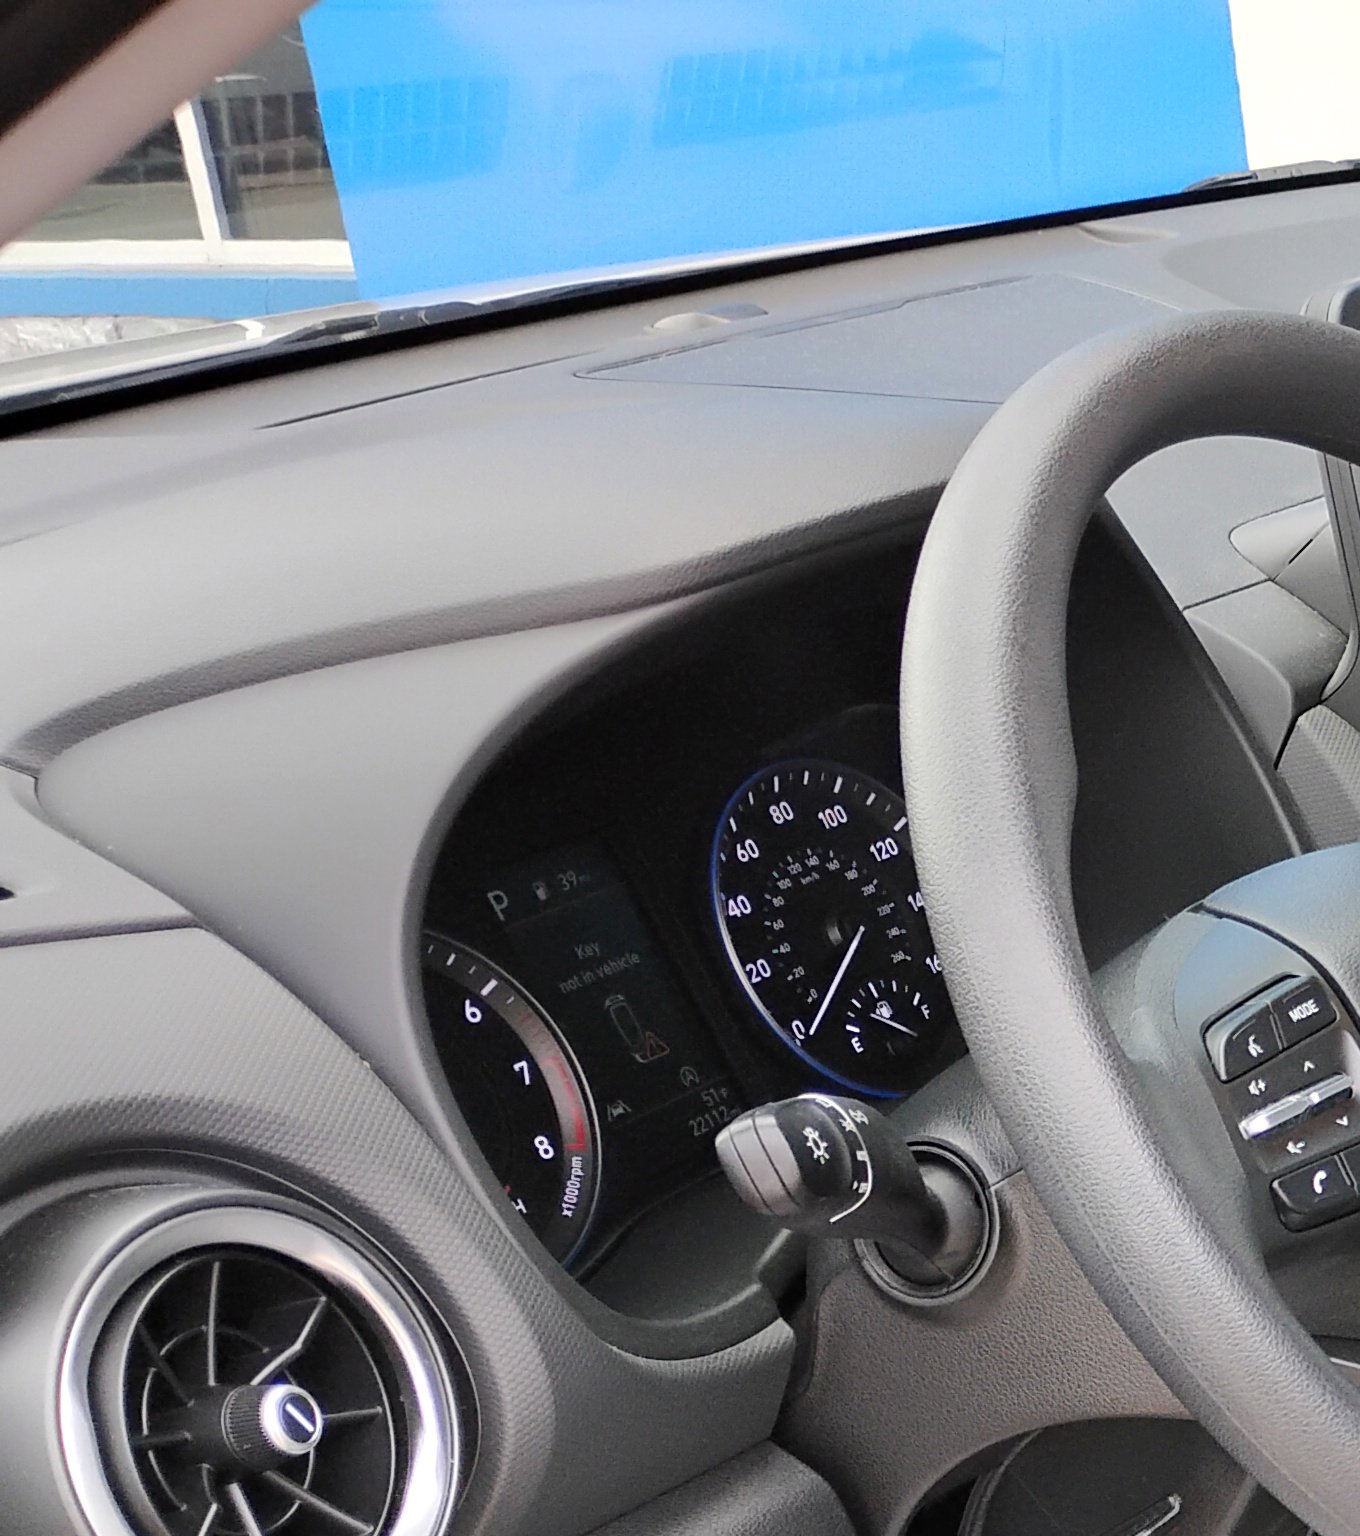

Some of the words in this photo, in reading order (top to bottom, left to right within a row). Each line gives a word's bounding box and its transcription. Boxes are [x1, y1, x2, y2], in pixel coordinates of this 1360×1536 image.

[769, 801, 794, 825] 80
[818, 804, 848, 830] 100
[736, 839, 760, 862] 60
[869, 837, 899, 862] 120
[787, 863, 802, 876] 120
[804, 855, 820, 868] 140
[826, 859, 840, 872] 160
[556, 870, 577, 891] 39
[776, 877, 792, 891] 100
[861, 884, 876, 897] 200
[487, 890, 508, 922] P
[727, 895, 751, 918] 40
[772, 896, 785, 907] 80
[907, 891, 925, 912] 14
[773, 919, 785, 931] 60
[574, 941, 600, 960] Key
[779, 942, 791, 954] 40
[559, 977, 580, 994] not
[582, 971, 596, 986] in
[598, 952, 640, 978] vehicle
[746, 958, 772, 983] 20
[793, 966, 805, 978] 20
[925, 954, 943, 974] 16
[464, 999, 482, 1024] 6
[921, 1004, 931, 1020] F
[1288, 999, 1320, 1024] MODE
[791, 1020, 806, 1040] 0
[851, 1036, 864, 1053] E
[513, 1060, 531, 1085] 7
[689, 1105, 731, 1136] 22112
[533, 1135, 555, 1160] 8
[561, 1156, 583, 1218] x1000rpm
